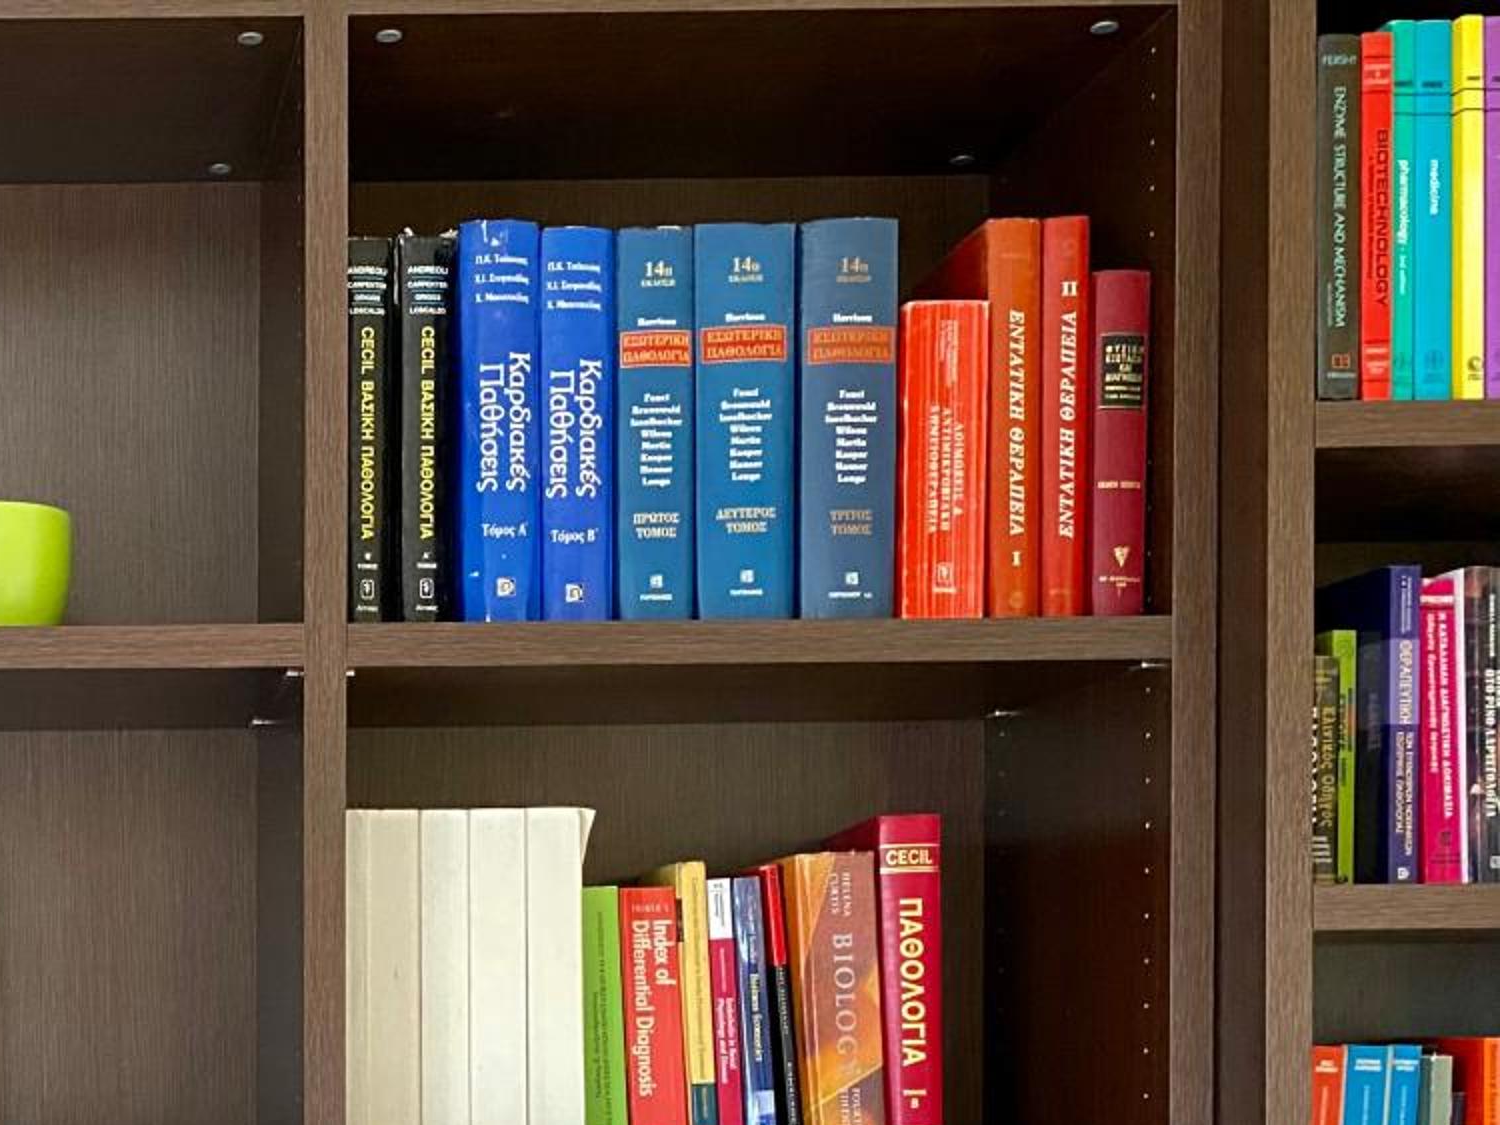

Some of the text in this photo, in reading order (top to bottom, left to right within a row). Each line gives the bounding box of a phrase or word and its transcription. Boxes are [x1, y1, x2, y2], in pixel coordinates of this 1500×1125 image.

[1331, 86, 1347, 328] ENZYME STRUCTURE AND MECHANISM
[1375, 128, 1389, 306] BIOTECHNOLOGY
[1396, 159, 1410, 245] pharmacology
[1429, 159, 1441, 216] medicine
[725, 312, 766, 323] Harrison
[361, 326, 375, 540] CECIL ΒΑΣΙΚΗ ΠΑΘΟΛΟΓΙΑ
[420, 326, 435, 540] CECIL ΒΑΣΙΚΗ ΠΑΘΟΛΟΓΙΑ
[476, 363, 504, 493] Παθήσεις
[506, 351, 531, 492] Καρδιακές
[547, 369, 575, 500] Παθήσεις
[576, 359, 603, 499] Καρδιακές
[1008, 309, 1025, 537] ΕΝΤΑΤΙΚΗ ΘΕΡΑΠΕΙΑ
[1058, 310, 1077, 539] ΕΝΤΑΤΙΚΗ ΘΕΡΑΠΕΙΑ
[1398, 638, 1413, 725] ΘΕΡΑΠΕΥΤΙΚΗ
[886, 848, 933, 866] CECIL
[1320, 775, 1333, 828] Οδηγός
[652, 919, 675, 986] Index of
[829, 872, 841, 915] CURTIS
[840, 871, 852, 917] HELENA
[631, 920, 655, 1098] Differential Diagnosis
[899, 897, 927, 1067] ΠΑΘΟΛΟΓΙΑ
